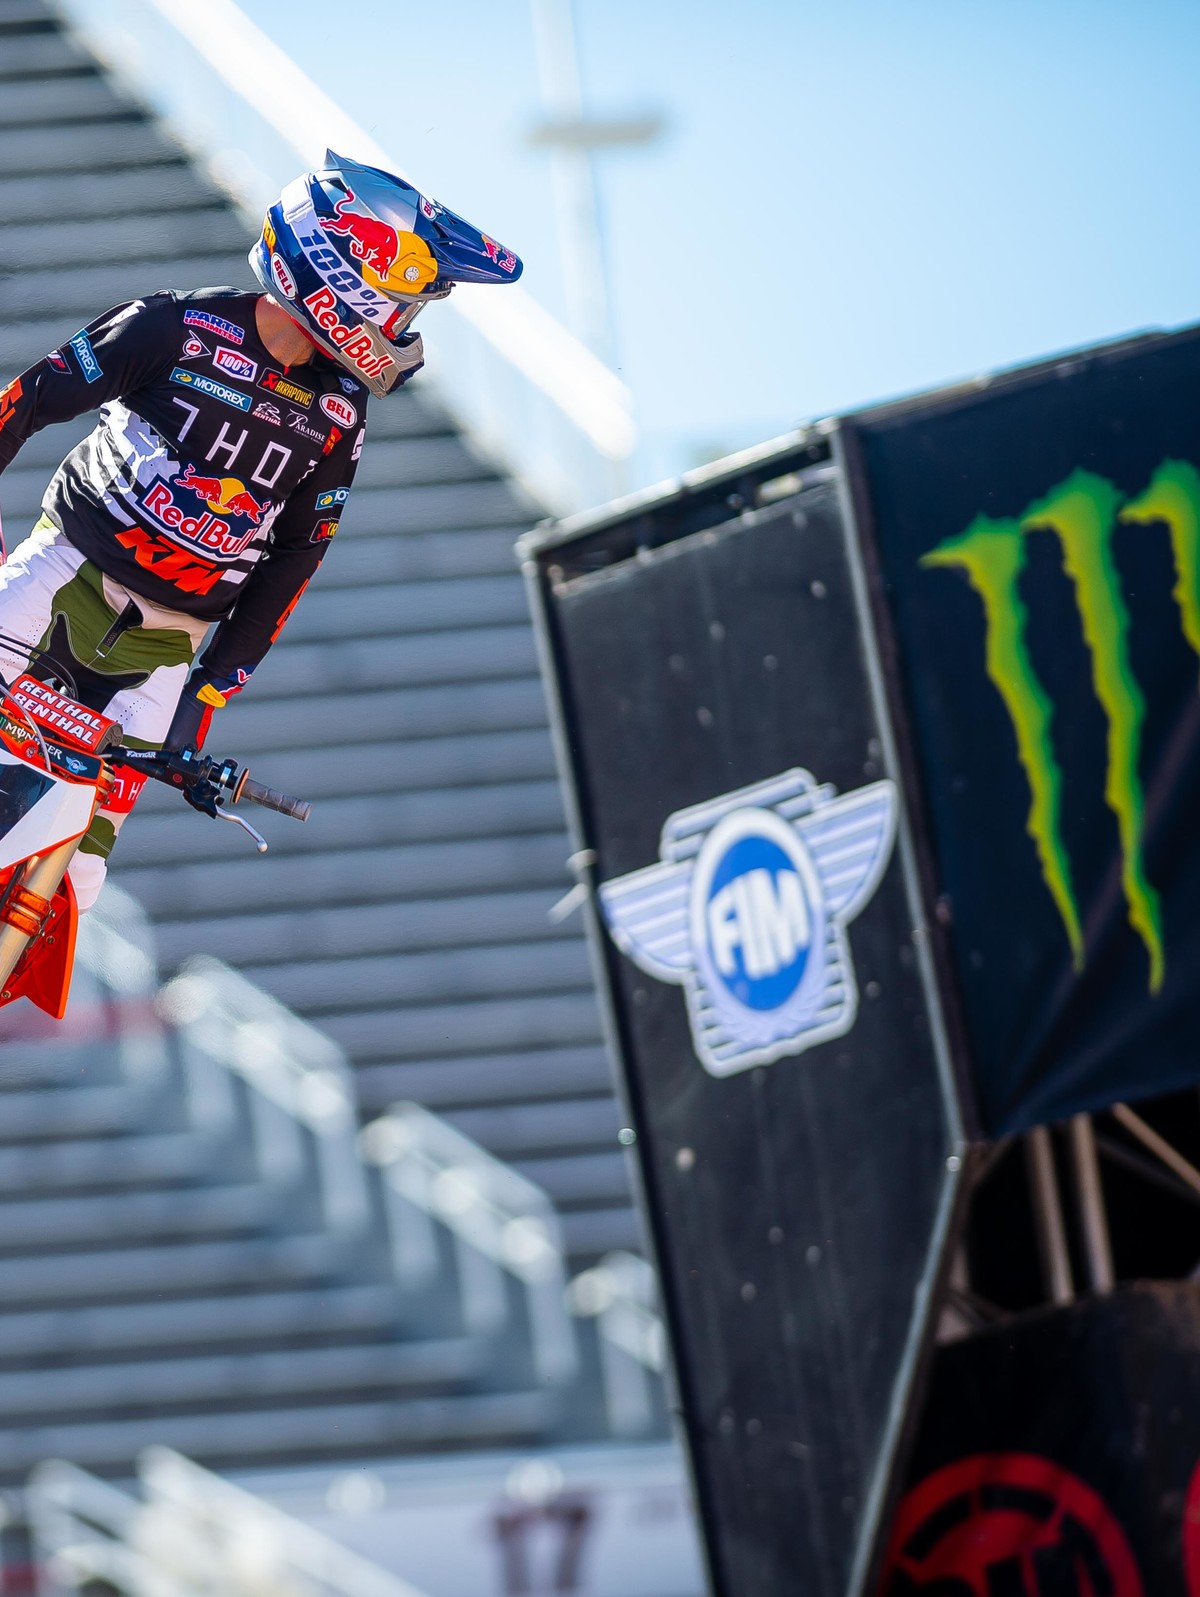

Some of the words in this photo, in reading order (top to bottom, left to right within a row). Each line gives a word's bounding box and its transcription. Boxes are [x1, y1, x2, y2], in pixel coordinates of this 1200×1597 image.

[274, 259, 293, 295] BELL
[300, 228, 389, 318] 100%
[183, 318, 242, 345] UNLIMITED
[185, 310, 245, 339] PARTS
[219, 353, 250, 376] 100%
[194, 377, 246, 407] MOTOREX
[252, 411, 281, 427] RENTHAL
[286, 409, 326, 443] PARADISE
[114, 526, 225, 596] KTM
[13, 692, 94, 745] RENTHAL
[18, 680, 101, 731] RENTHAL
